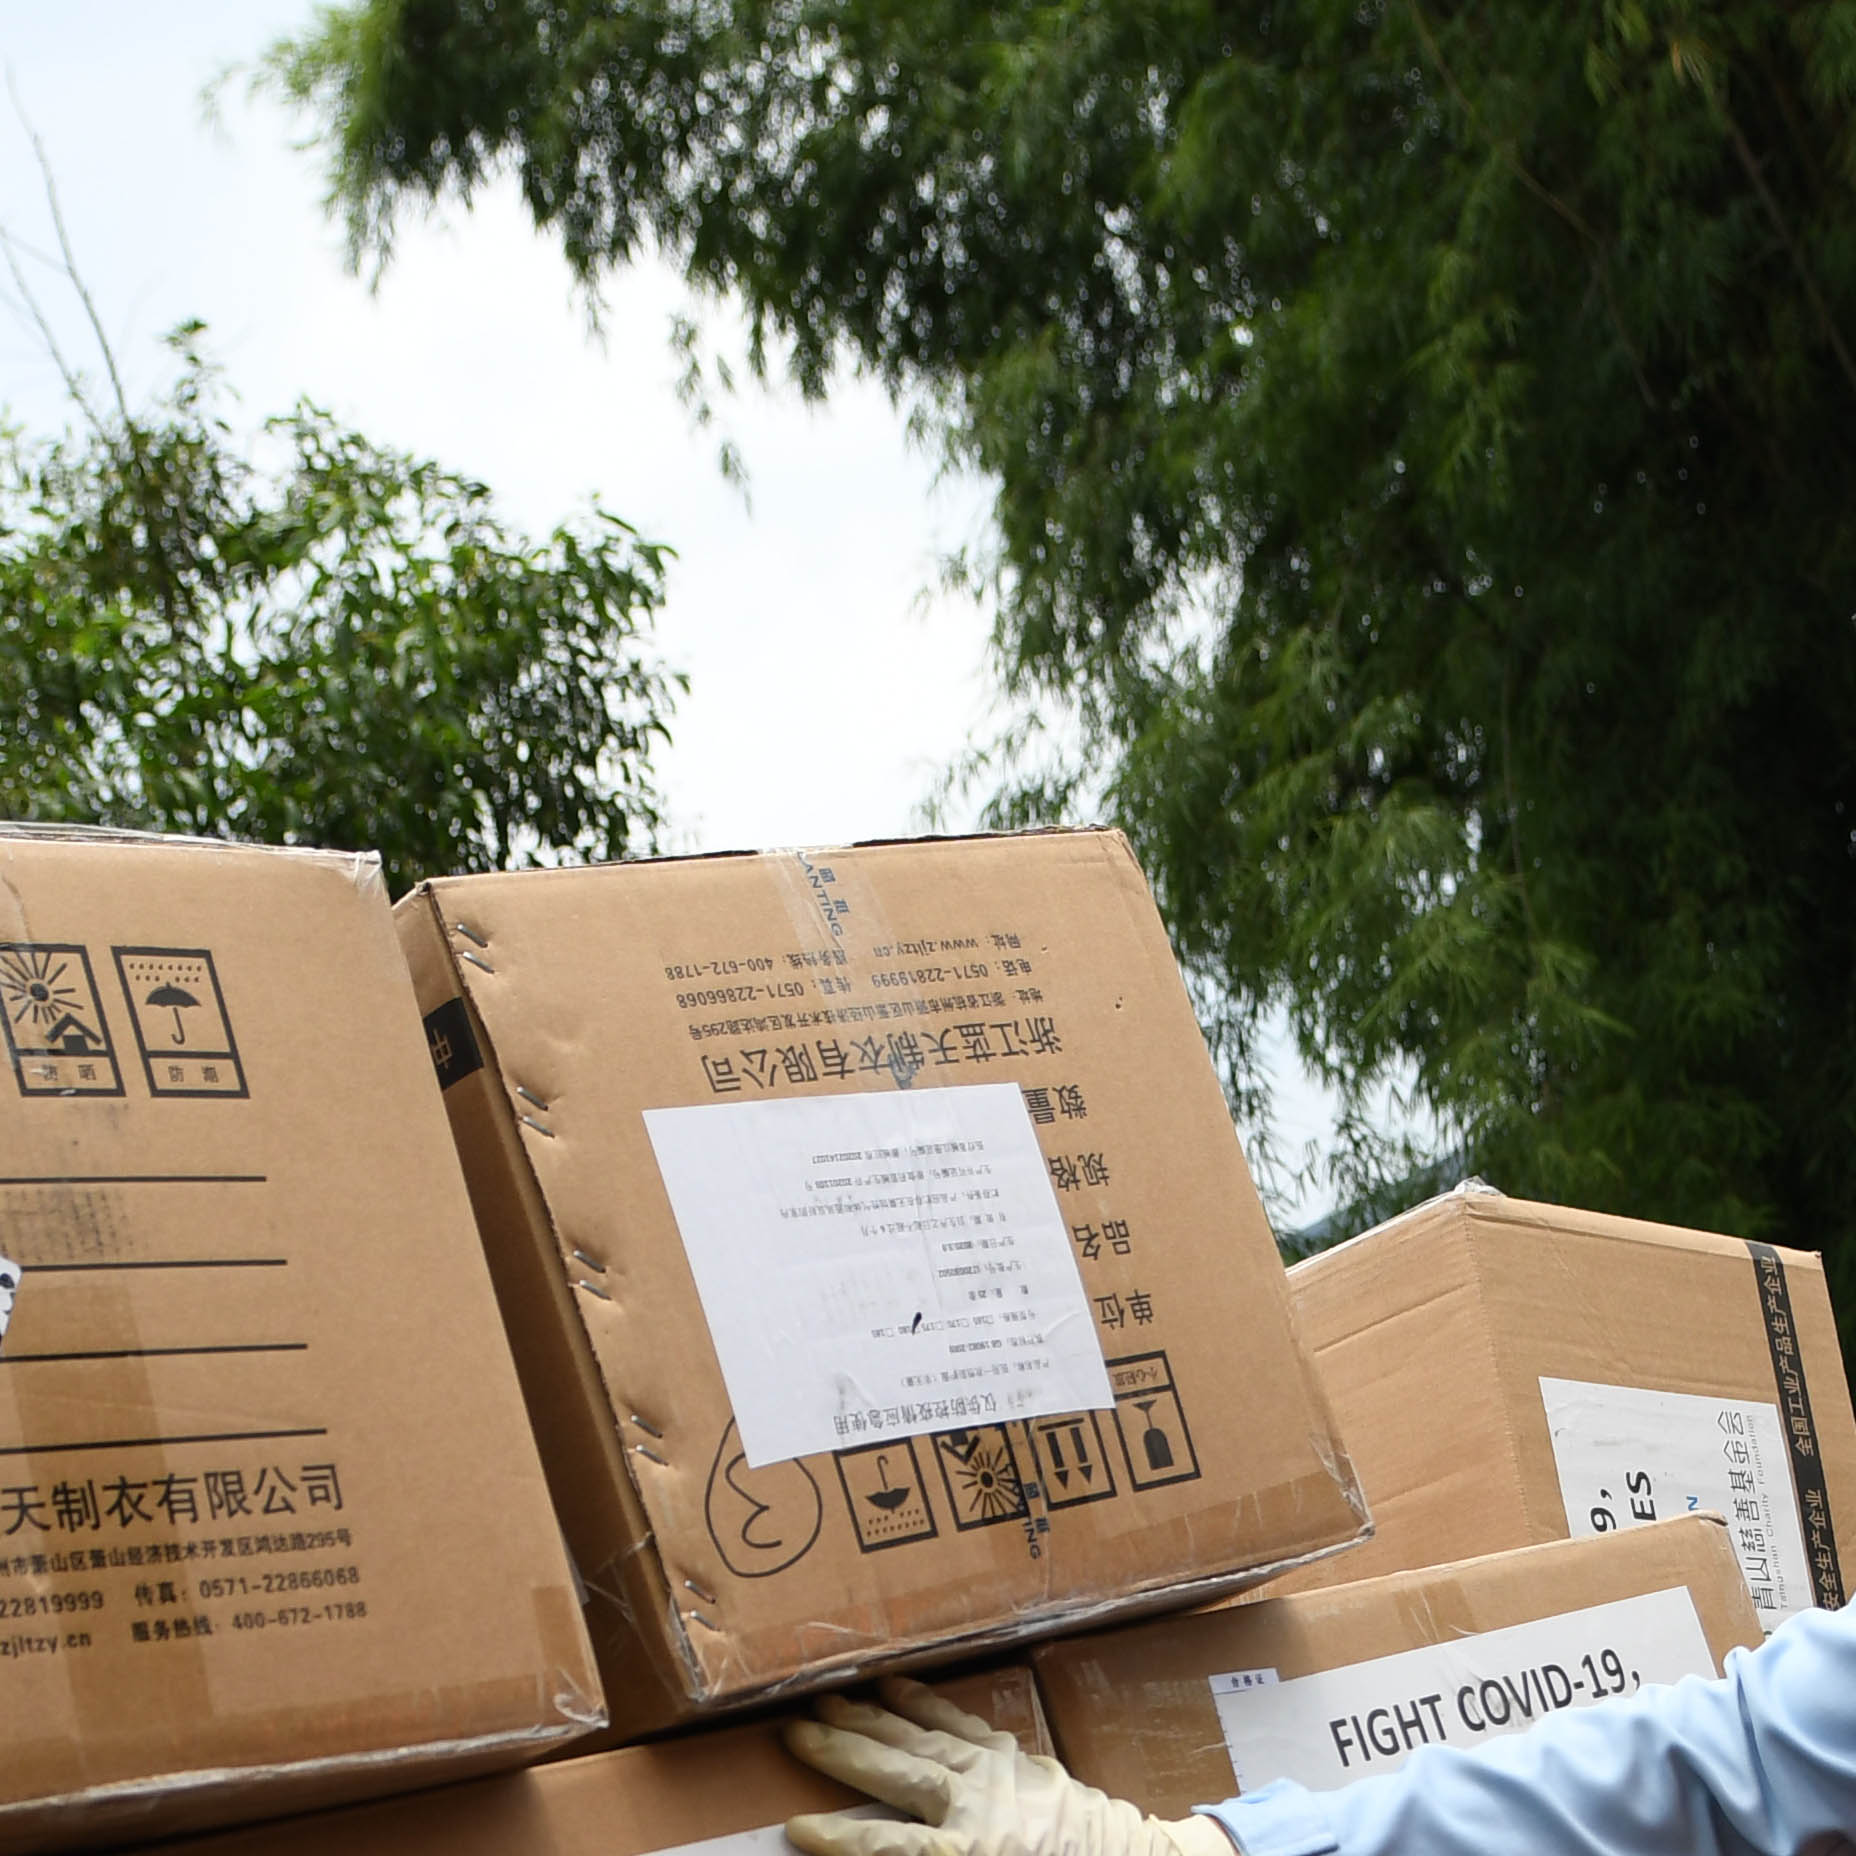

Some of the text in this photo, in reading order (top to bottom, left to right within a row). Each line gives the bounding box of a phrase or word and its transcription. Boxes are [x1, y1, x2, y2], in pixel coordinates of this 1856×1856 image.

[664, 957, 774, 981] 400-672-1788
[871, 963, 989, 987] 0571-22819999
[675, 981, 805, 1009] 0571-22866068
[699, 1014, 1061, 1096] 浙江蓝天制衣有限公司
[1758, 1251, 1813, 1457] 全国工业产品生产企业
[833, 1392, 997, 1436] 仅供防控疫情应急使用
[198, 1565, 360, 1599] 0571-22866068
[231, 1601, 368, 1631] 400-672-1788
[1329, 1647, 1644, 1769] FIGHT COVID-19,
